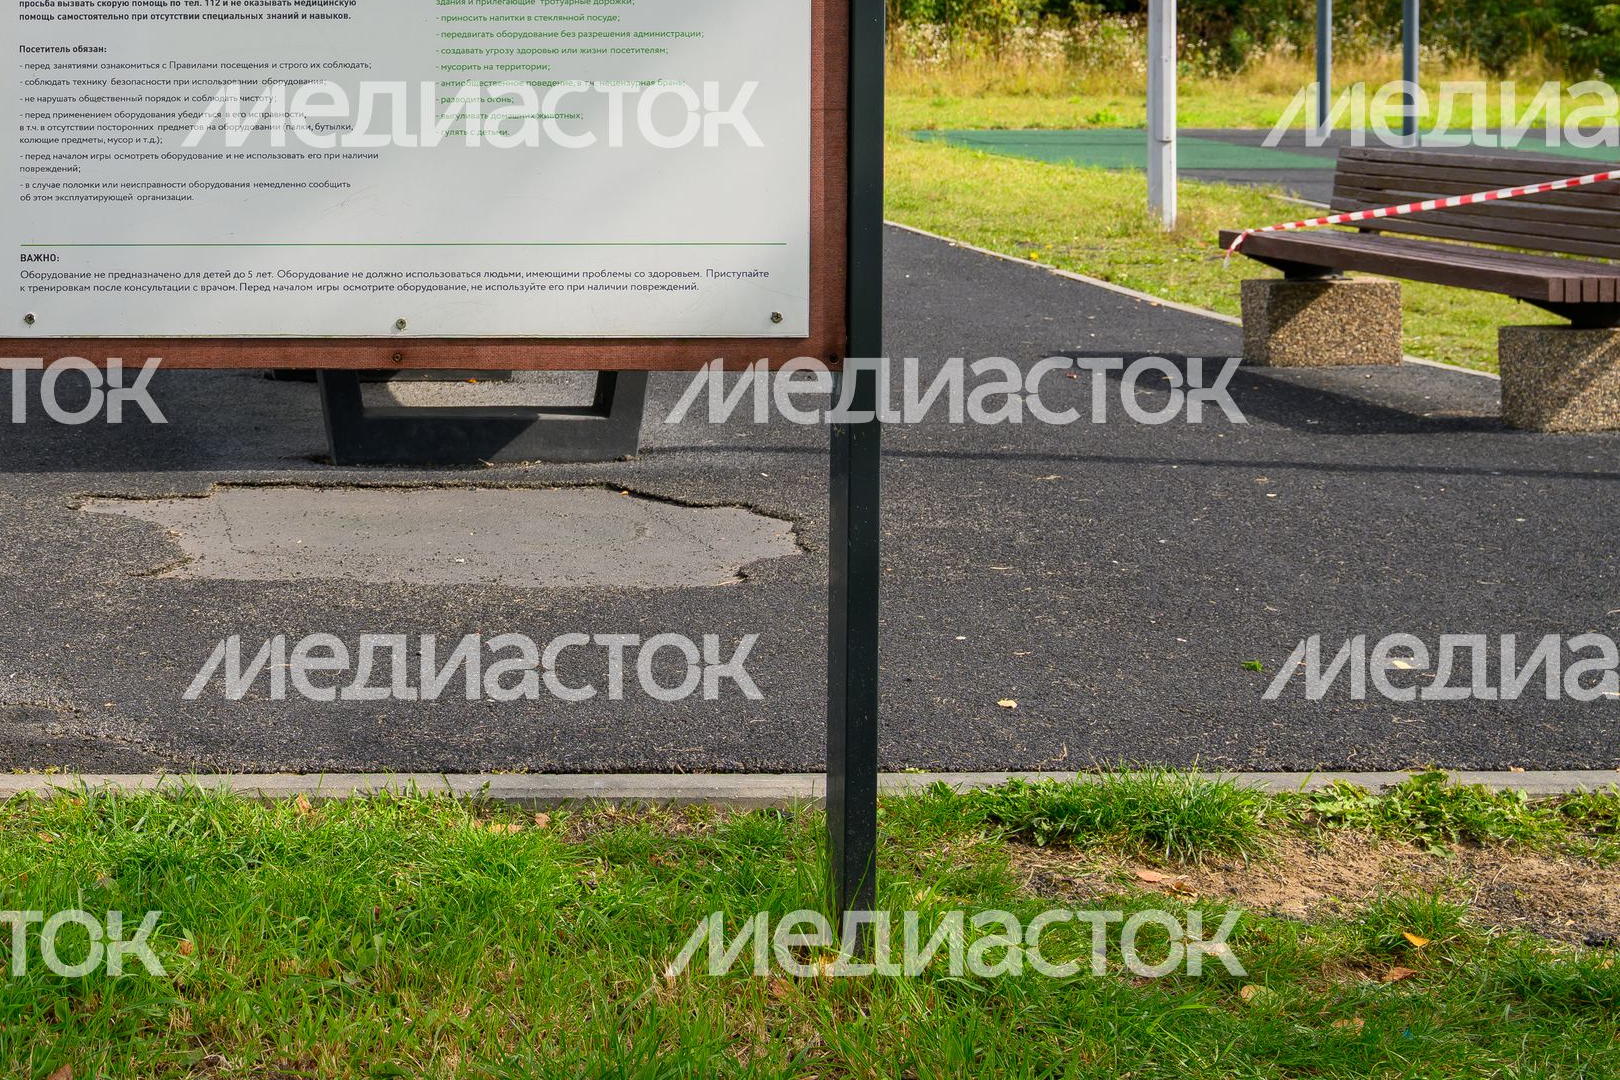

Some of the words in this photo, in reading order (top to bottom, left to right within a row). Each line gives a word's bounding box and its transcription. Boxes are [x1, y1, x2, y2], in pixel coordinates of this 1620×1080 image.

[95, 0, 130, 9] скорую
[130, 0, 168, 8] помощь
[182, 0, 203, 7] тел.
[242, 0, 292, 7] оказывать
[292, 0, 357, 9] медицинскую
[18, 13, 55, 22] помощь
[130, 13, 148, 22] при
[149, 13, 200, 22] отсутствии
[200, 13, 264, 21] специальных
[265, 11, 299, 20] знаний
[439, 14, 488, 24] приносить
[488, 14, 525, 22] напитки
[532, 12, 585, 22] стеклянной
[585, 14, 620, 24] посуде;
[18, 44, 71, 53] Посетитель
[71, 43, 107, 53] обязан:
[18, 137, 60, 145] колющие
[60, 137, 106, 146] предметы,
[106, 137, 134, 146] мусор
[141, 134, 163, 146] т.д.);
[18, 163, 81, 175] повреждений;
[54, 192, 134, 203] эксплуатирующей
[135, 194, 195, 203] организации.
[19, 253, 60, 262] ВАЖНО:
[19, 269, 92, 281] Оборудование
[107, 271, 182, 281] предназначено
[182, 271, 201, 280] для
[201, 269, 231, 280] детей
[275, 269, 350, 280] Оборудование
[364, 271, 404, 280] должно
[482, 271, 524, 279] людьми,
[524, 271, 580, 279] имеющими
[581, 268, 632, 280] проблемы
[646, 270, 702, 280] здоровьем.
[705, 268, 770, 280] Приступайте
[26, 284, 91, 294] тренировкам
[92, 284, 122, 292] после
[123, 284, 191, 294] консультации
[199, 284, 238, 294] врачом.
[238, 282, 272, 293] Перед
[315, 284, 340, 293] игры
[341, 284, 395, 293] осмотрите
[395, 281, 469, 293] оборудование,
[484, 282, 547, 293] используйте
[547, 283, 565, 291] его
[565, 283, 585, 293] при
[586, 283, 628, 291] наличии
[629, 281, 699, 293] повреждений.
